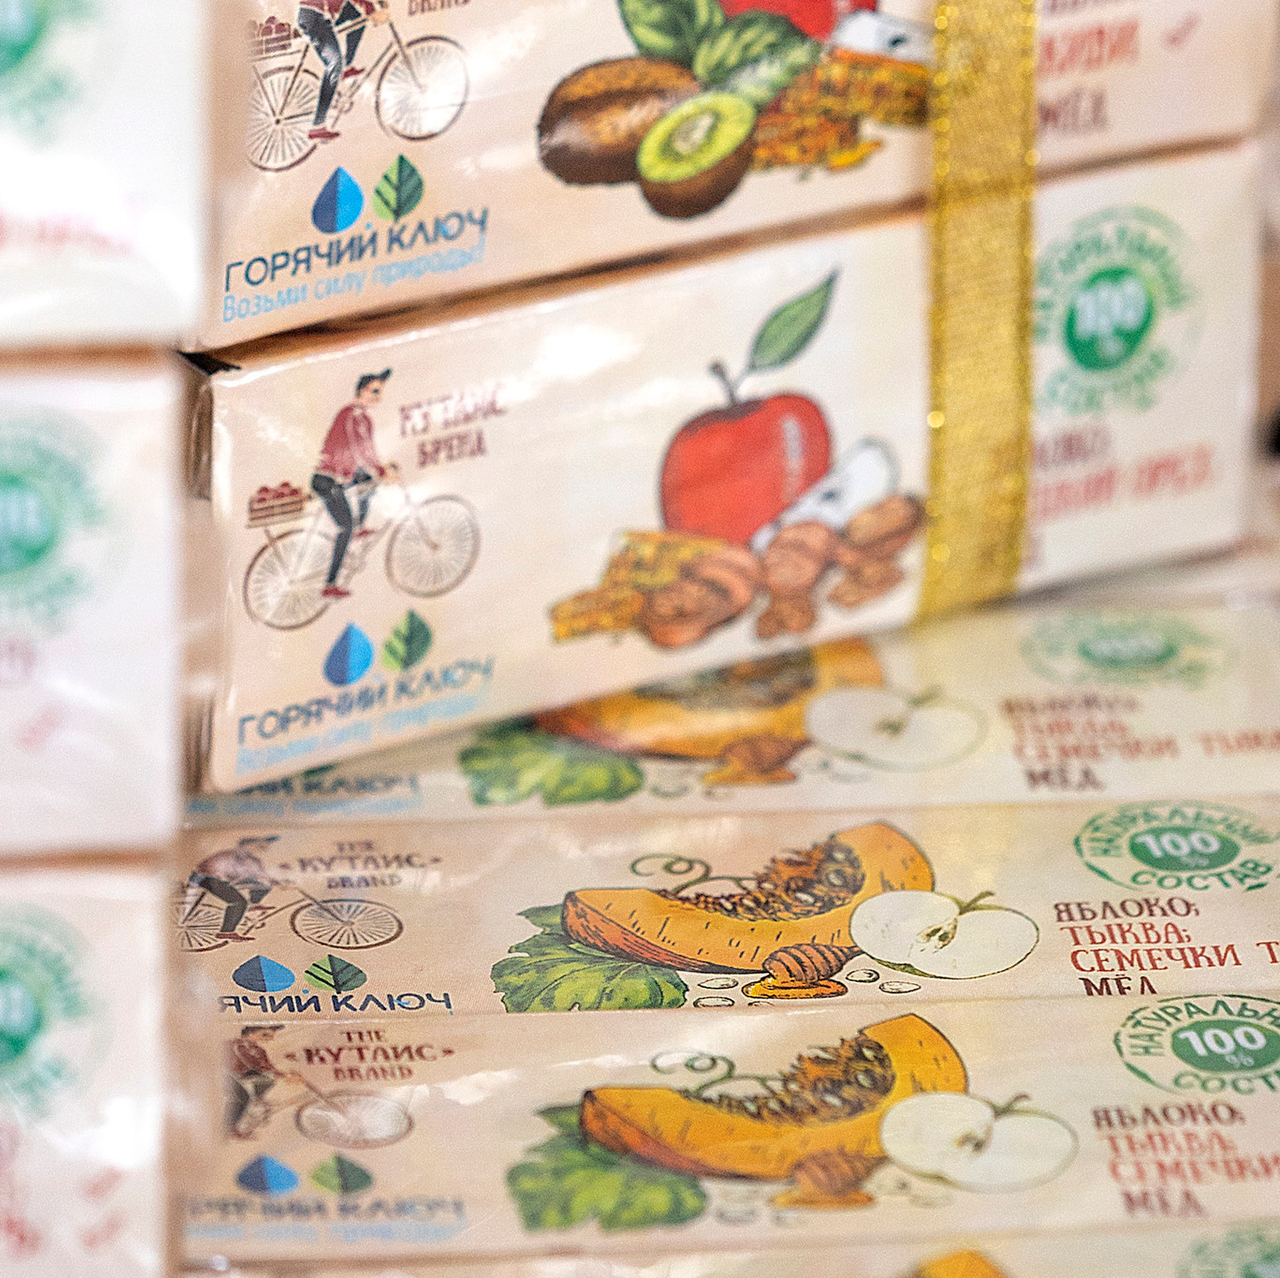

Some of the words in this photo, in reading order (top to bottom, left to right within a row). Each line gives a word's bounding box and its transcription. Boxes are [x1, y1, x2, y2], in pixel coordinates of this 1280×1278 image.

[225, 222, 378, 292] ГОРЯЧИЙ
[388, 206, 489, 255] КЛЮЧ
[1136, 830, 1221, 858] 100
[1131, 858, 1273, 891] СОСТАВ
[1053, 896, 1200, 923] ЯБЛОКО;
[1060, 921, 1192, 946] ТЫКВА;
[1070, 943, 1242, 973] СЕМЕЧКИ
[219, 988, 321, 1013] ЯЧИЙ
[332, 992, 453, 1013] КЛЮЧ
[339, 1029, 387, 1043] THE
[1177, 1025, 1267, 1057] 100
[332, 1065, 414, 1082] BRAND
